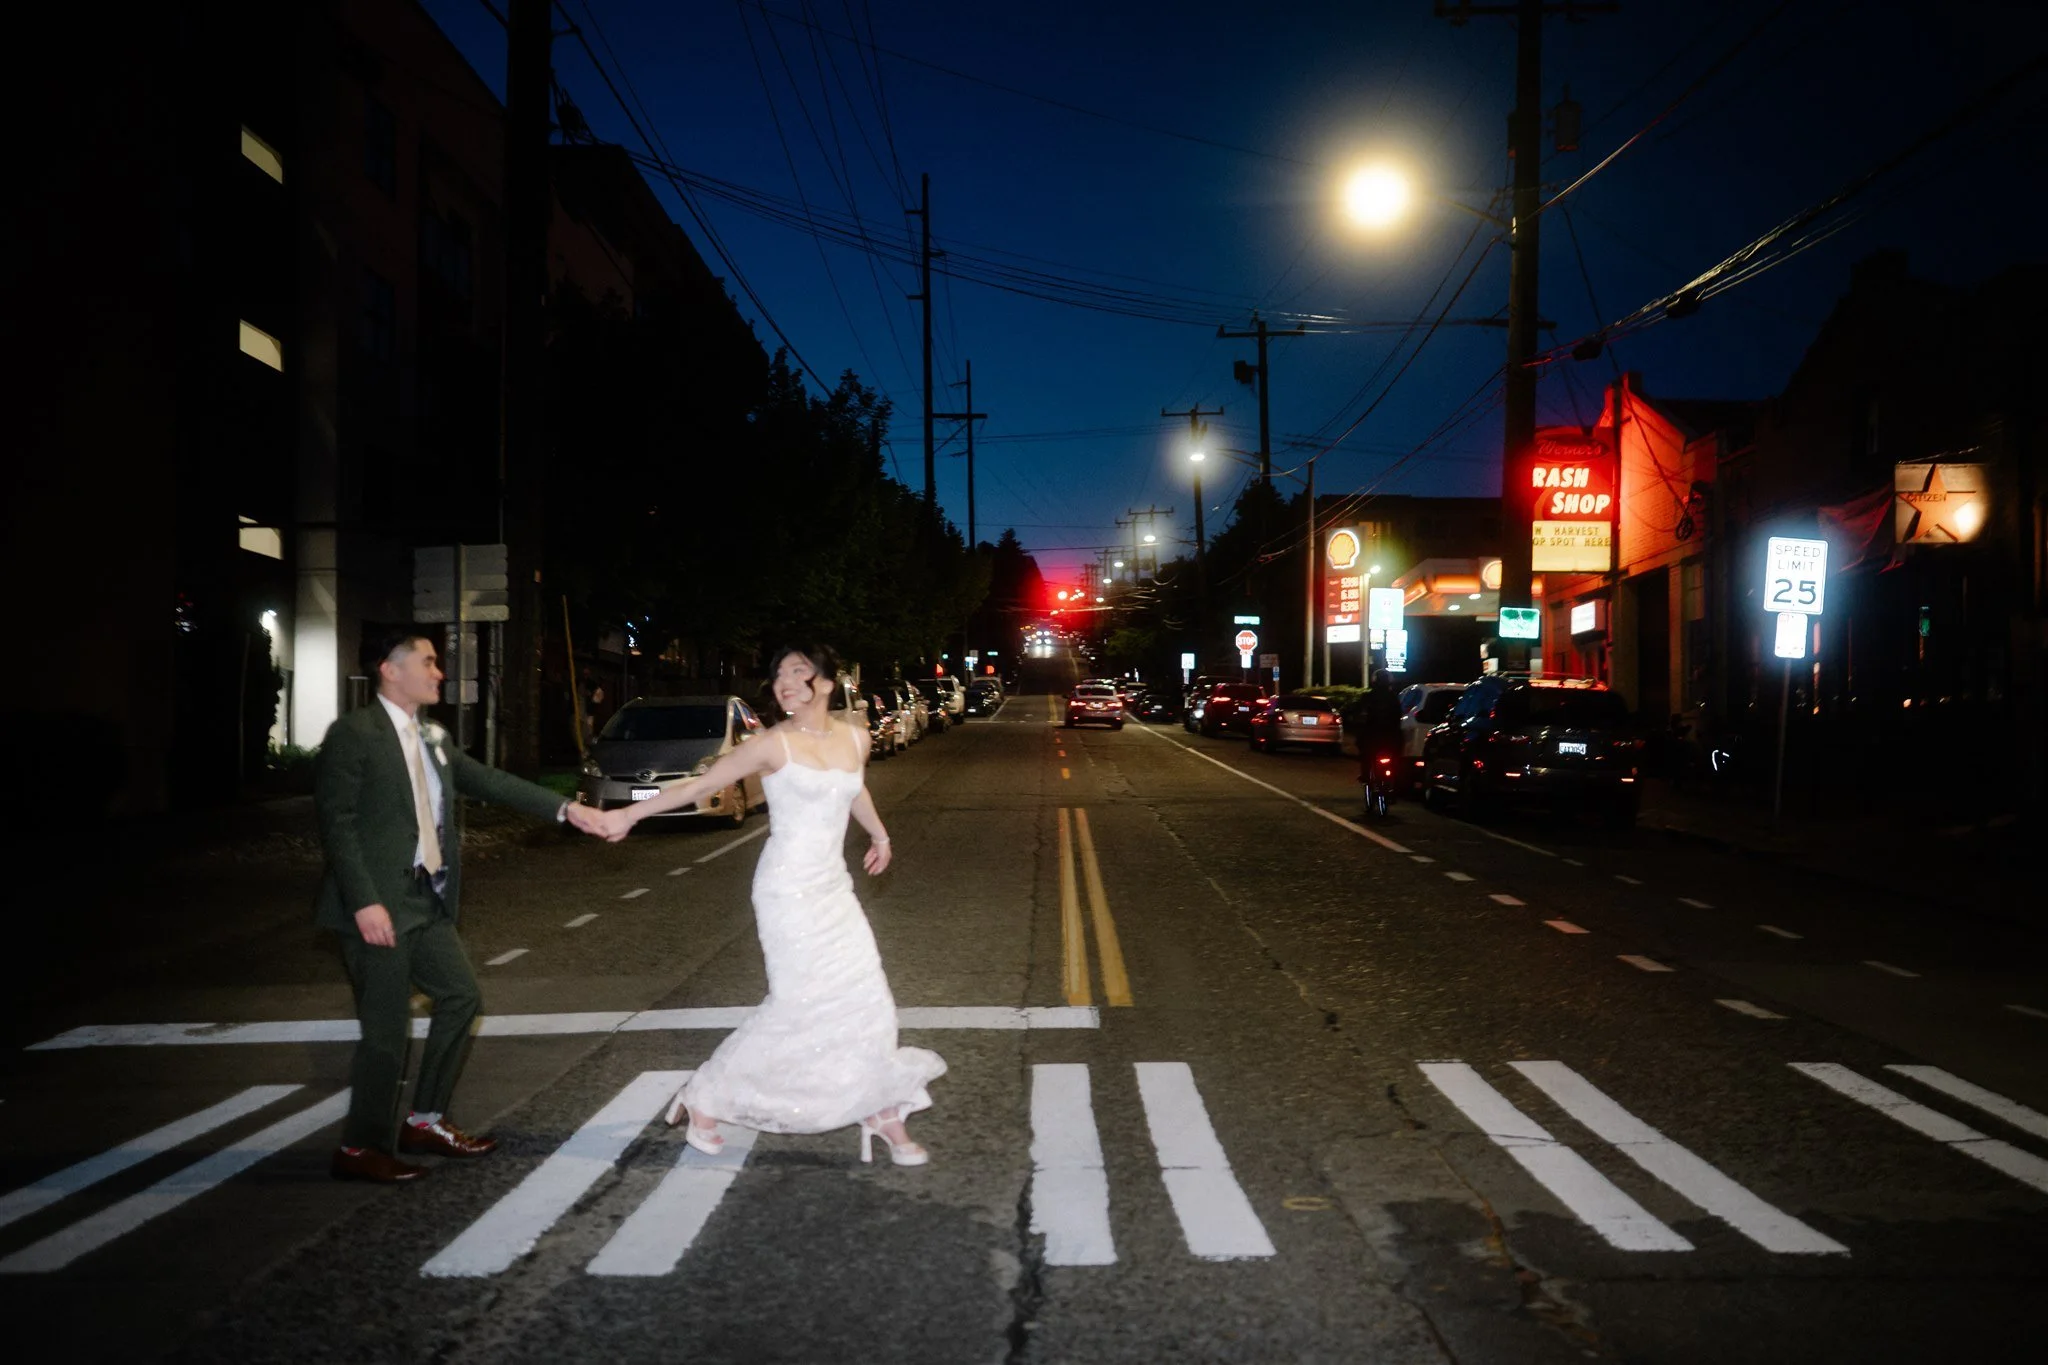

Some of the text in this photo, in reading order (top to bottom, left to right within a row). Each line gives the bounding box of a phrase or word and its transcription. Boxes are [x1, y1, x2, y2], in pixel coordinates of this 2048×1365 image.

[1532, 467, 1589, 488] RASH
[1551, 492, 1610, 514] SHOP
[1907, 493, 1947, 502] CITIZEN
[1554, 526, 1599, 536] HARVEST
[1532, 537, 1611, 547] OP SPOT HERE
[1775, 544, 1821, 558] SPEED
[1777, 560, 1815, 571] LIMIT
[1772, 578, 1816, 605] 25
[1237, 636, 1256, 646] STOP
